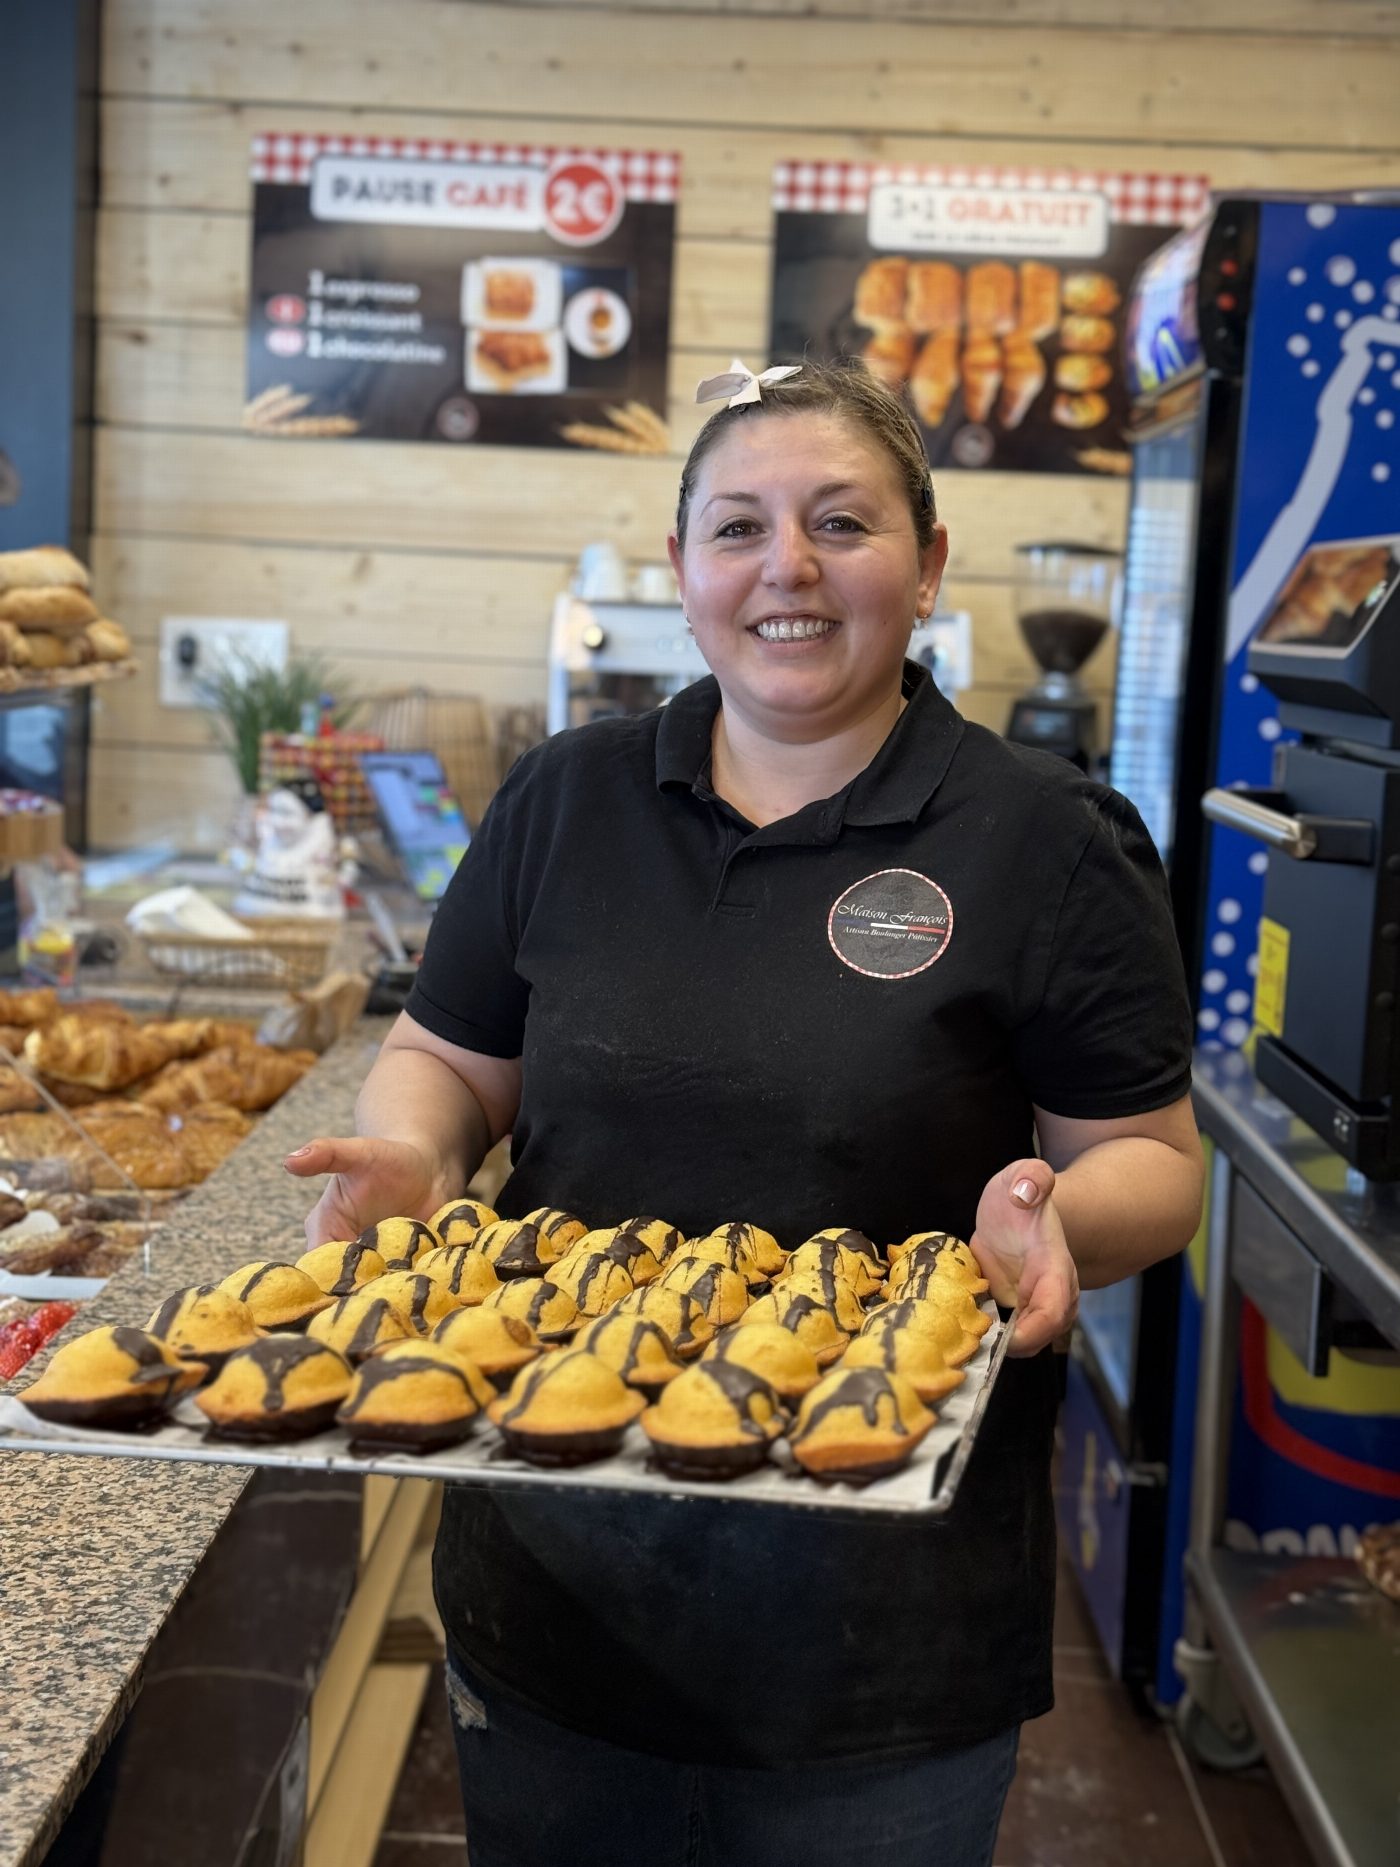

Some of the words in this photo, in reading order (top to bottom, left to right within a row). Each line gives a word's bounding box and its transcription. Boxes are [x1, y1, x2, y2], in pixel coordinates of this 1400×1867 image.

[331, 174, 435, 207] PAUSE
[447, 175, 529, 211] CAFÉ
[550, 177, 612, 226] 2€
[946, 196, 1092, 228] GRATUIT
[309, 269, 324, 297] 1
[309, 299, 323, 327] 1
[307, 329, 322, 358] 1
[838, 904, 887, 919] Maison
[889, 911, 948, 926] François
[843, 926, 870, 935] Artisan
[870, 929, 907, 940] Boulanger
